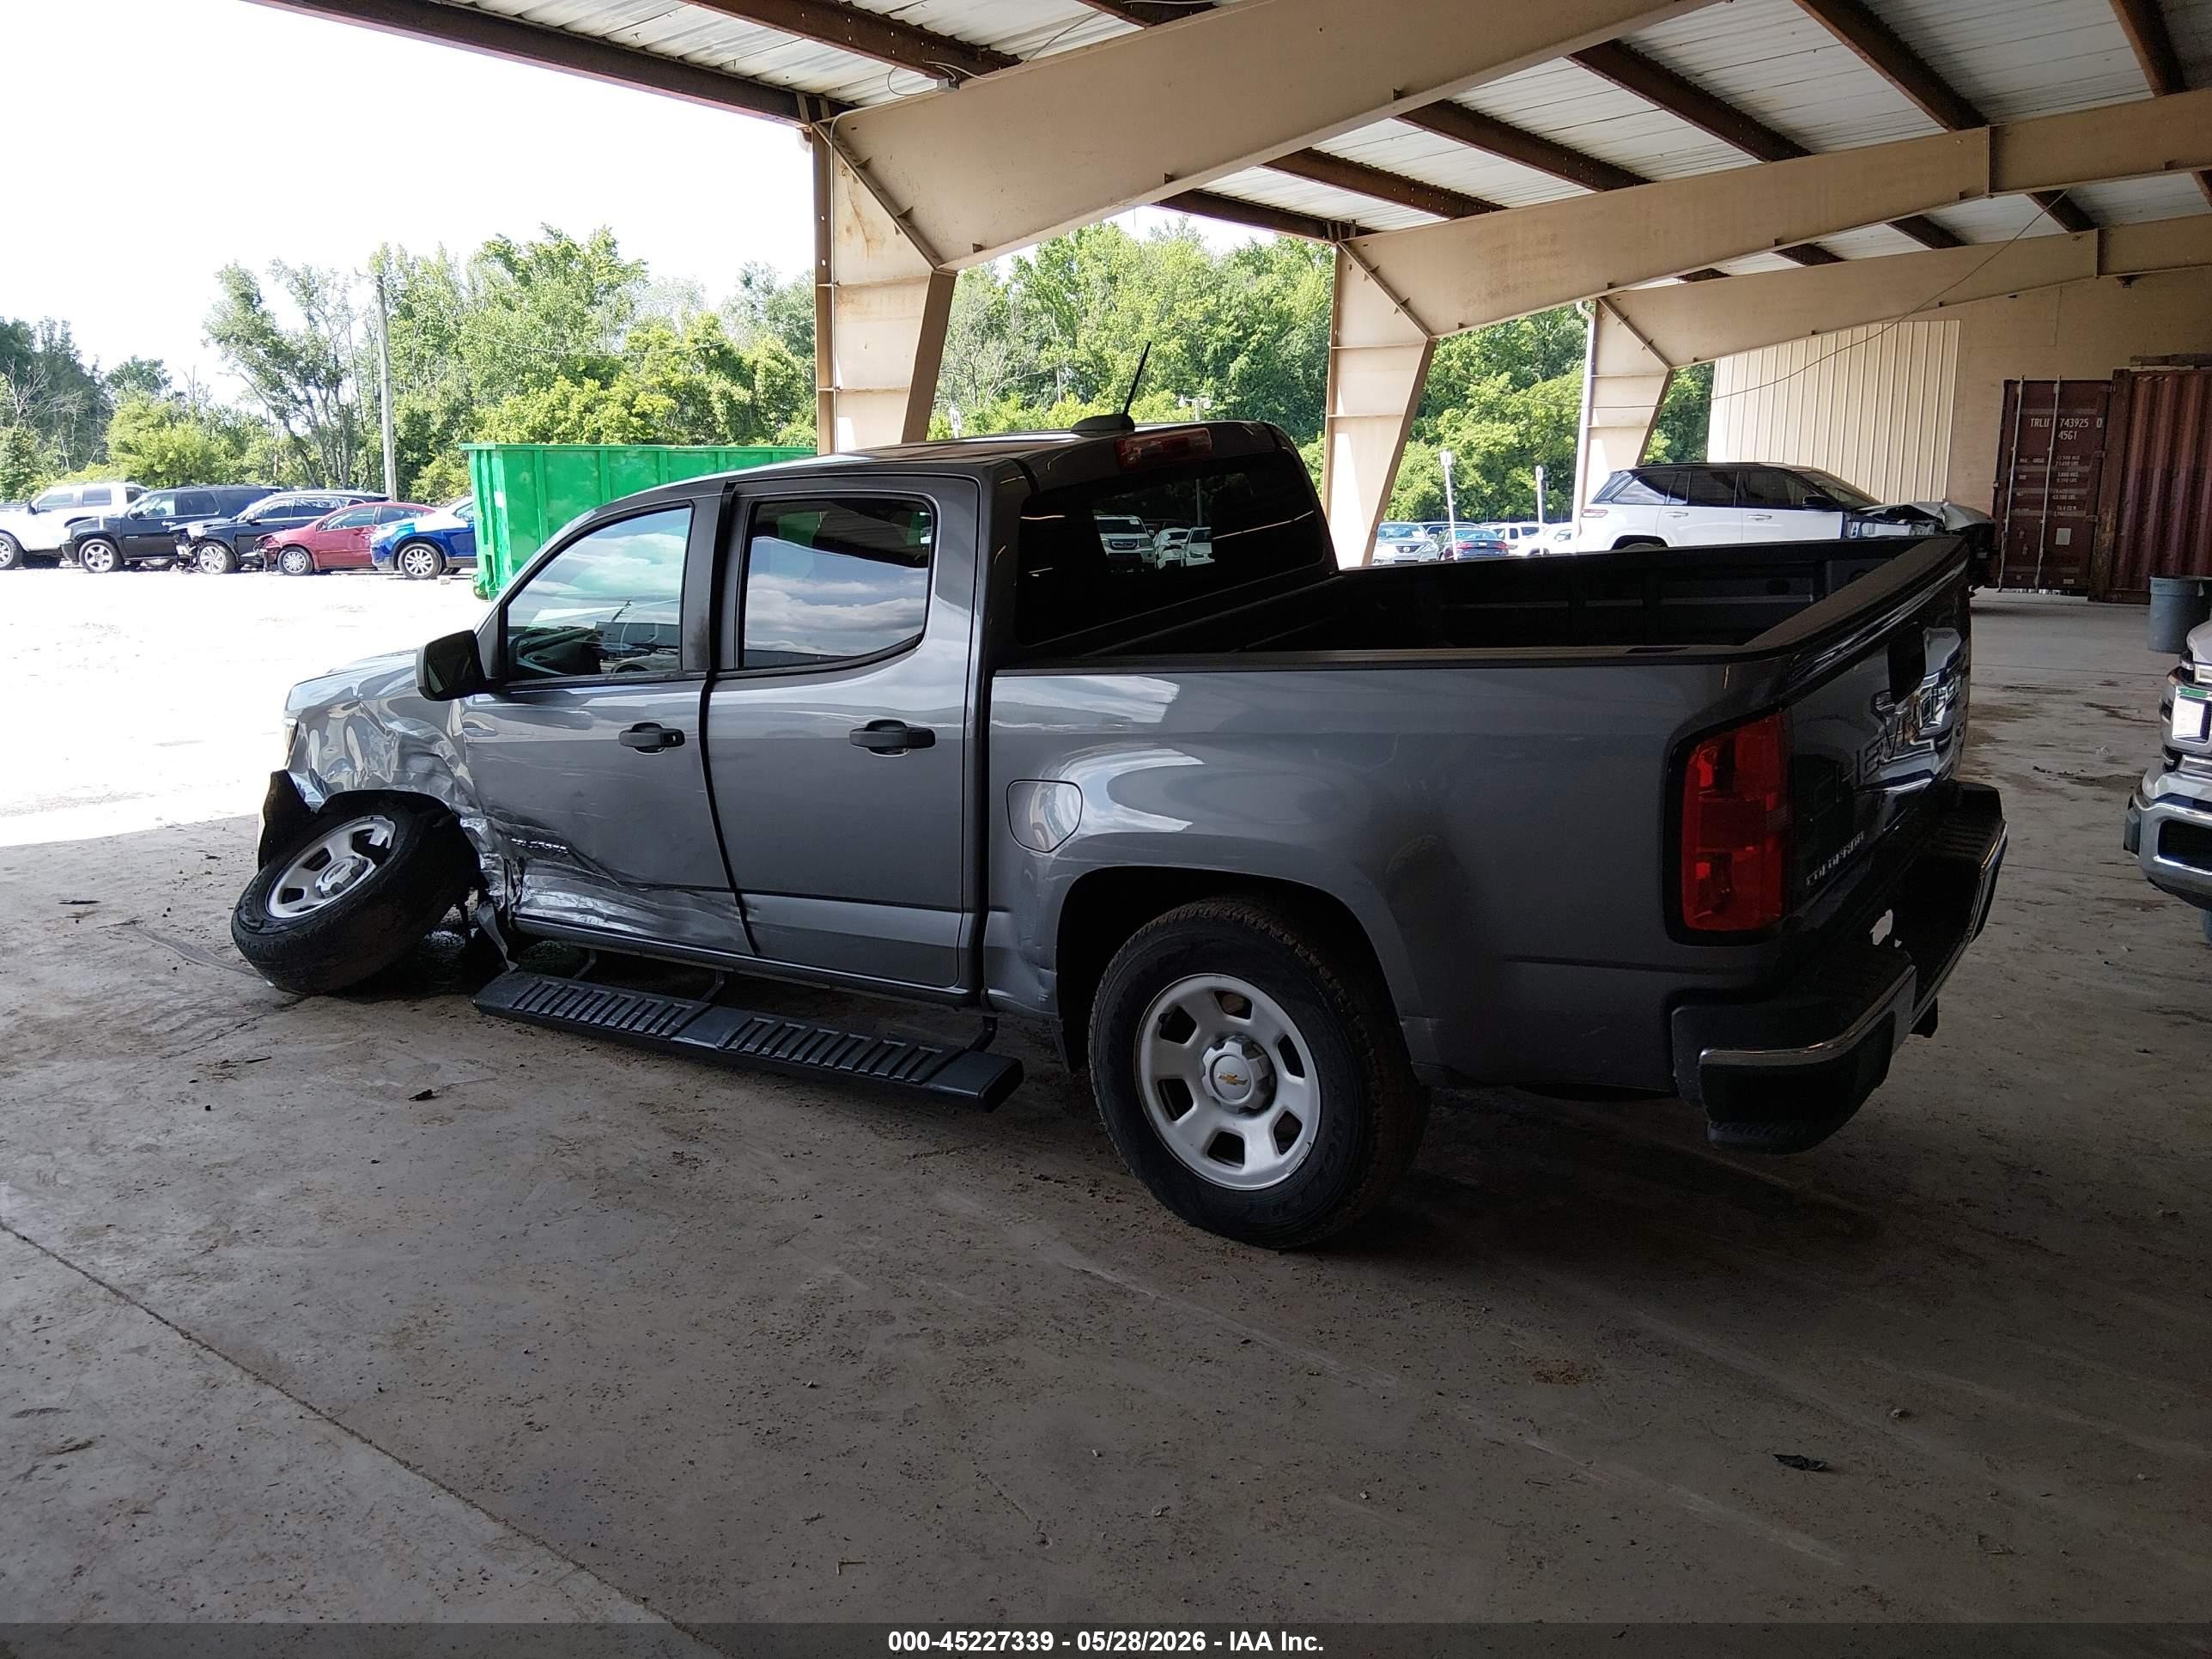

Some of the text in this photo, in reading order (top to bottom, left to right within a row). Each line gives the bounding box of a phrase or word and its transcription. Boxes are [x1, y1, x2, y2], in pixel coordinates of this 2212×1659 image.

[2030, 417, 2103, 428] TRLU 743925 0
